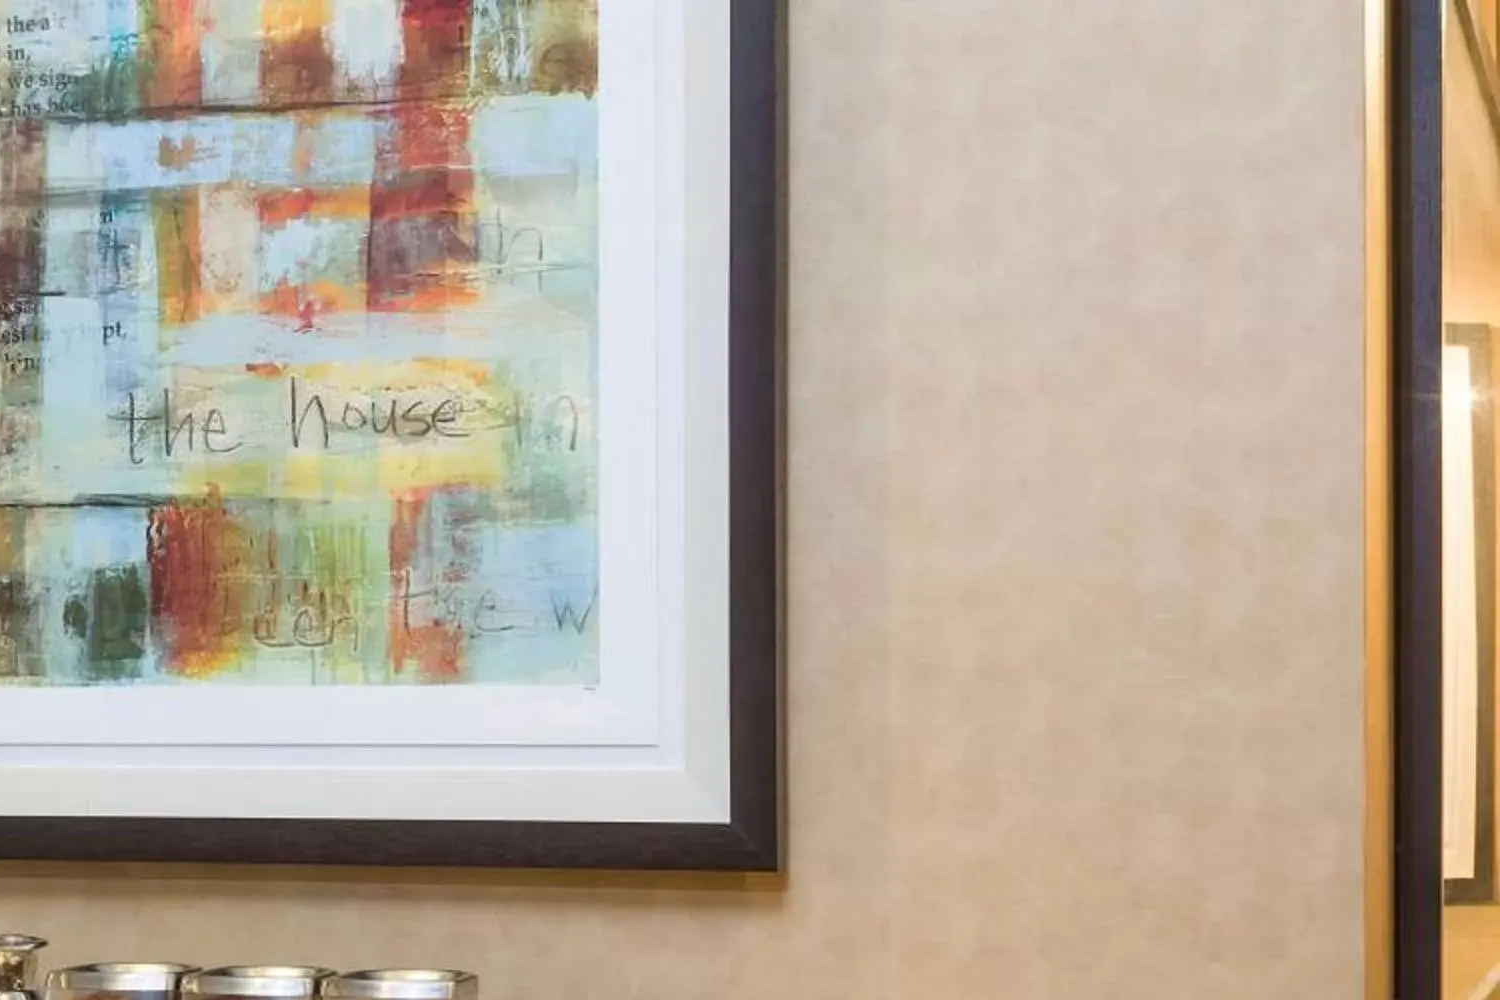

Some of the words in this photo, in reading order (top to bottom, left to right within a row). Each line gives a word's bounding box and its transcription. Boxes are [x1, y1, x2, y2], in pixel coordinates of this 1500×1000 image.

[6, 15, 34, 34] the
[7, 44, 32, 63] in,
[7, 75, 36, 91] we
[101, 321, 128, 346] pt,
[107, 387, 242, 465] the
[291, 376, 471, 450] house
